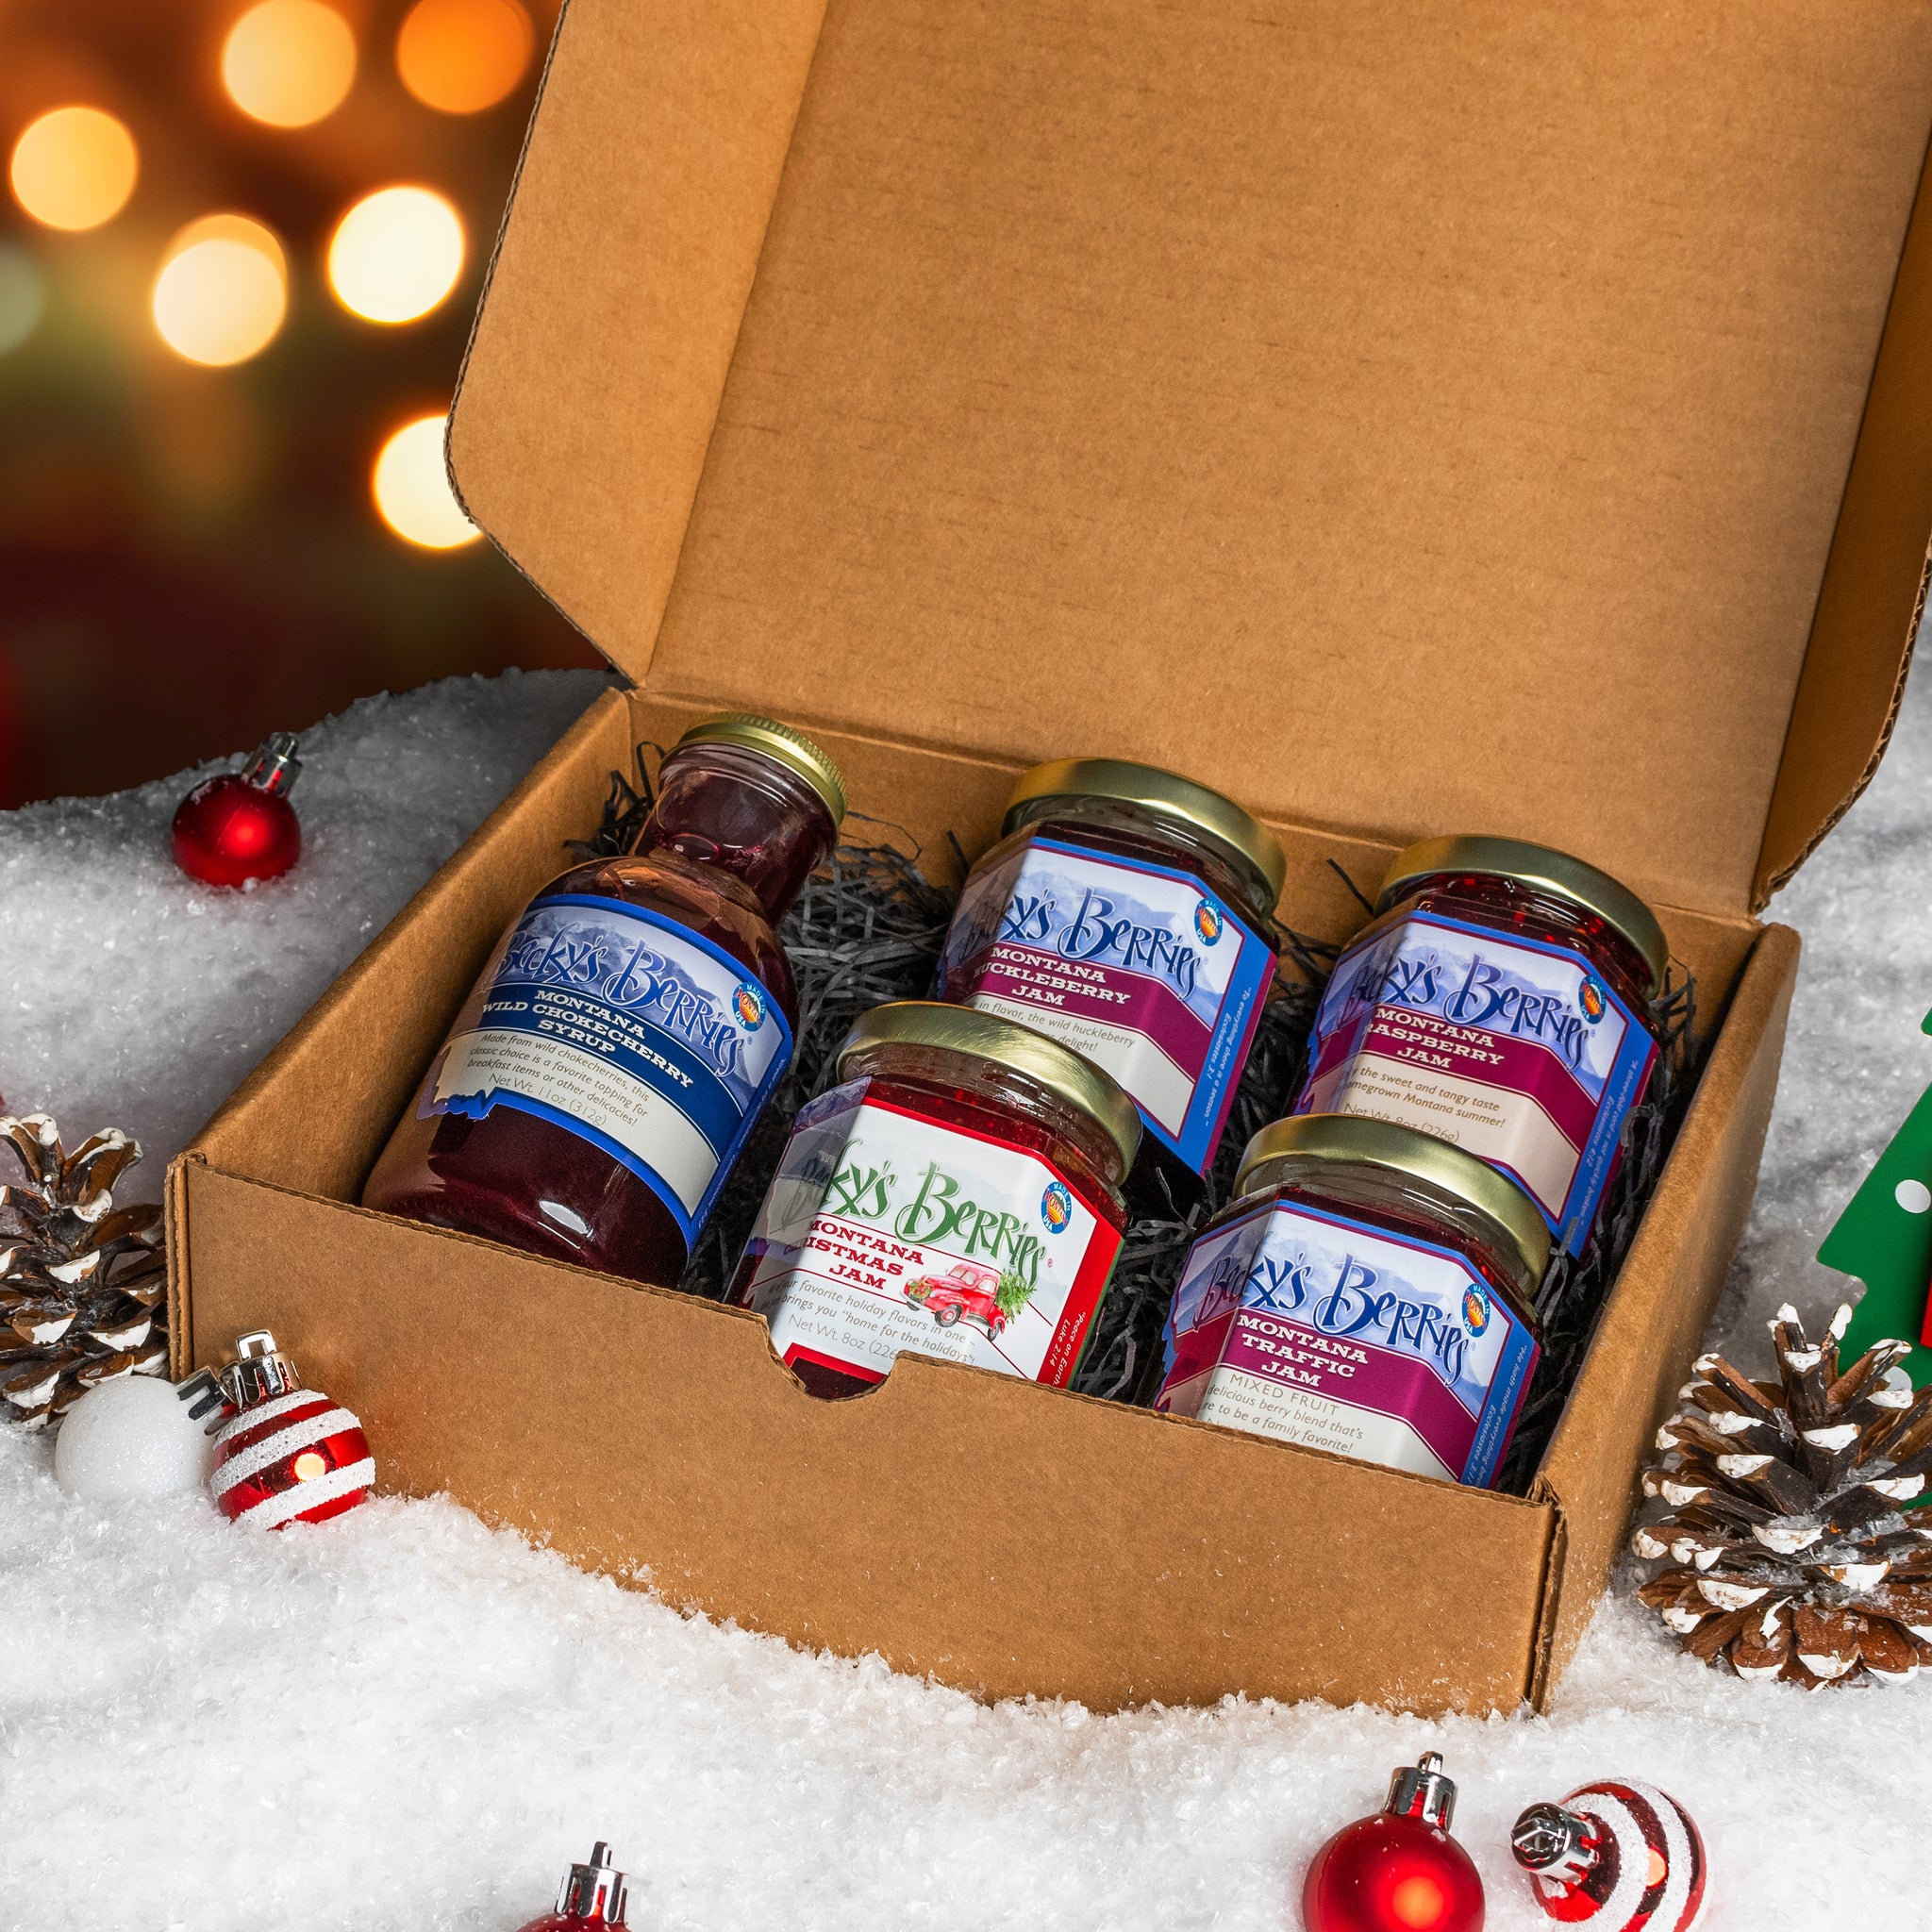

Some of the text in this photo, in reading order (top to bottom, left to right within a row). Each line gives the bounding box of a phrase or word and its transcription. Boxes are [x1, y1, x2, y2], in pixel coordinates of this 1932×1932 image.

[1197, 928, 1207, 943] USA
[991, 946, 1107, 984] MONTANA
[534, 990, 646, 1040] MONTANA
[1011, 985, 1065, 1007] JAM
[538, 1019, 617, 1054] SYRUP
[736, 1010, 746, 1026] USA
[978, 1000, 991, 1010] in
[991, 1002, 1024, 1021] flavor,
[1027, 1013, 1046, 1025] the
[1048, 1018, 1072, 1031] wild
[1073, 1023, 1136, 1049] huckleberry
[1375, 1008, 1495, 1048] MONTANA
[483, 1001, 694, 1089] WILD CHOKECHERRY
[1058, 1036, 1099, 1053] delight!
[1220, 1046, 1231, 1070] there
[1397, 1047, 1452, 1069] JAM
[470, 1046, 498, 1056] classic
[499, 1047, 530, 1061] choice
[532, 1054, 541, 1064] is
[552, 1061, 592, 1084] favorite
[594, 1080, 633, 1109] topping
[632, 1103, 648, 1117] for
[480, 1033, 650, 1102] Made from wild chokecherries, this
[467, 1058, 639, 1127] breakfast items or other delicacies!
[488, 1073, 511, 1087] Net
[514, 1078, 534, 1094] Wt.
[569, 1098, 608, 1127] (312g)
[1345, 1080, 1507, 1128] megrown Montana summer!
[1360, 1067, 1379, 1079] the
[1380, 1074, 1412, 1089] sweet
[1415, 1081, 1438, 1095] and
[1439, 1089, 1470, 1106] tangy
[1472, 1097, 1500, 1112] taste
[1043, 1214, 1053, 1231] USA
[784, 1236, 904, 1274] CISTMAS
[829, 1263, 887, 1290] JAM
[782, 1292, 814, 1311] brings
[815, 1305, 838, 1318] you
[879, 1324, 898, 1338] for
[900, 1332, 920, 1345] the
[788, 1313, 814, 1332] Net
[817, 1322, 838, 1341] Wt.
[841, 1332, 866, 1350] 8oz
[799, 1279, 843, 1303] favorite
[845, 1294, 887, 1319] holiday
[888, 1309, 928, 1330] flavors
[930, 1324, 941, 1335] in
[944, 1330, 967, 1343] one
[1464, 1317, 1474, 1334] USA
[1050, 1319, 1071, 1367] Luke 2:14
[1064, 1343, 1072, 1357] on
[1237, 1314, 1369, 1365] MONTANA
[1241, 1333, 1356, 1378] TRAFFIC
[1229, 1374, 1284, 1399] MIXED
[1291, 1392, 1341, 1416] FRUIT
[1261, 1360, 1322, 1388] JAM
[1509, 1363, 1521, 1386] hath
[1208, 1384, 1255, 1406] delicious
[1259, 1399, 1291, 1419] berry
[1293, 1409, 1328, 1428] blend
[1329, 1423, 1364, 1440] that's
[1500, 1387, 1511, 1415] made
[1219, 1403, 1230, 1414] to
[1233, 1407, 1249, 1421] be
[1252, 1416, 1260, 1424] a
[1262, 1417, 1300, 1440] family
[1301, 1429, 1354, 1453] favorite!
[1474, 1404, 1497, 1461] Ecclesiastes
[1482, 1416, 1502, 1465] everything
